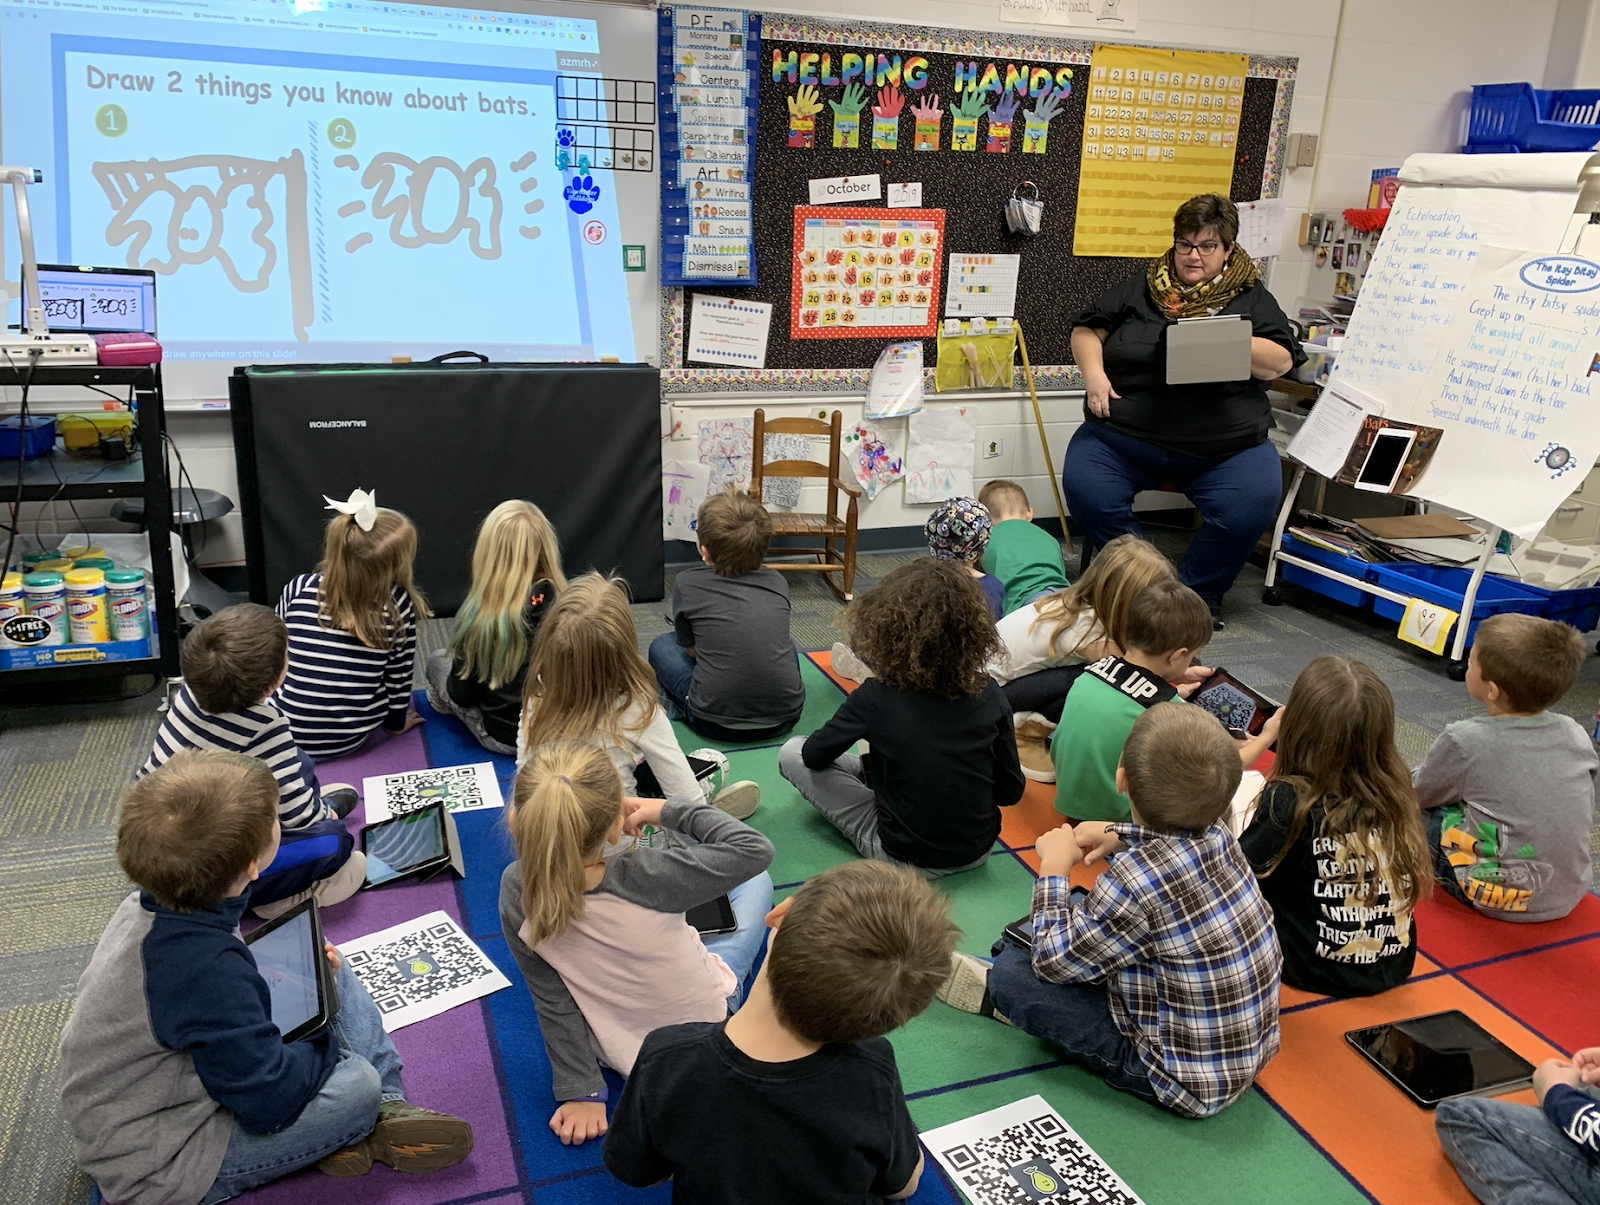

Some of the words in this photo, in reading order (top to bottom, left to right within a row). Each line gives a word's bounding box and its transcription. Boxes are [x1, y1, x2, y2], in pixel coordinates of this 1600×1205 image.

[689, 32, 718, 42] Morning
[560, 57, 592, 68] azmrh
[705, 52, 732, 61] Special
[772, 49, 928, 90] HELPING
[700, 74, 739, 86] Centers
[954, 61, 1074, 99] HANDS
[87, 65, 154, 92] Draw
[167, 70, 183, 93] 2
[194, 72, 272, 105] things
[282, 85, 325, 108] you
[336, 81, 393, 107] know
[404, 87, 468, 112] about
[478, 91, 536, 117] bats.
[706, 94, 734, 104] Lunch
[105, 110, 119, 131] 1
[689, 108, 725, 123] Spanish
[334, 124, 352, 143] 2
[682, 132, 711, 141] Carpet
[713, 133, 730, 141] time
[704, 149, 746, 161] Calendar
[697, 166, 720, 179] Art
[715, 187, 745, 199] Writing
[826, 182, 871, 195] October
[893, 188, 917, 203] 2019
[718, 207, 747, 217] Recess
[1405, 206, 1461, 223] Echolocation
[718, 225, 744, 235] Snack
[1397, 223, 1420, 240] Sleep
[1455, 225, 1478, 240] down
[693, 244, 717, 253] Math
[1390, 239, 1408, 255] They
[1429, 247, 1442, 255] see
[1446, 248, 1463, 260] very
[688, 260, 736, 272] Dismissal
[1384, 255, 1402, 271] They
[1535, 261, 1552, 272] The
[1554, 264, 1573, 276] Itsy
[1574, 266, 1598, 279] Bitsy
[1421, 275, 1438, 289] and
[1545, 275, 1576, 287] Spider
[1493, 285, 1510, 301] The
[1516, 290, 1537, 310] itsy
[1541, 293, 1568, 314] bitsy
[1469, 299, 1496, 319] Crept
[1499, 311, 1511, 323] up
[1514, 314, 1525, 323] on
[1474, 319, 1486, 335] He
[1488, 324, 1525, 342] wriggled
[1528, 331, 1546, 346] all
[1548, 338, 1582, 353] around
[163, 350, 187, 359] draw
[189, 350, 236, 360] anywhere
[238, 351, 251, 359] on
[253, 350, 270, 359] this
[272, 350, 297, 359] slide!
[1466, 335, 1485, 352] Then
[1488, 343, 1508, 357] used
[1510, 346, 1520, 360] it
[1522, 347, 1536, 363] for
[1549, 352, 1568, 370] bed
[1445, 349, 1457, 366] He
[1460, 359, 1501, 374] scampered
[1501, 360, 1522, 380] down
[1570, 377, 1592, 396] back
[1446, 368, 1464, 385] And
[1465, 372, 1495, 392] hopped
[1495, 379, 1517, 398] down
[1519, 385, 1529, 400] to
[1532, 387, 1546, 405] the
[1440, 384, 1459, 402] Then
[1462, 390, 1479, 406] that
[1482, 395, 1498, 415] itsy
[1500, 399, 1520, 420] bitsy
[1521, 407, 1548, 425] spider
[309, 420, 367, 429] BALANCEFROM
[1364, 418, 1389, 430] Bats
[1426, 399, 1463, 421] Squeezed
[1464, 410, 1501, 432] underneath
[1505, 421, 1517, 436] the
[112, 600, 142, 615] CLOROX
[21, 620, 44, 632] FREE
[1120, 670, 1159, 699] UP
[1316, 919, 1372, 945] TRISTEN
[1315, 940, 1353, 964] NATE
